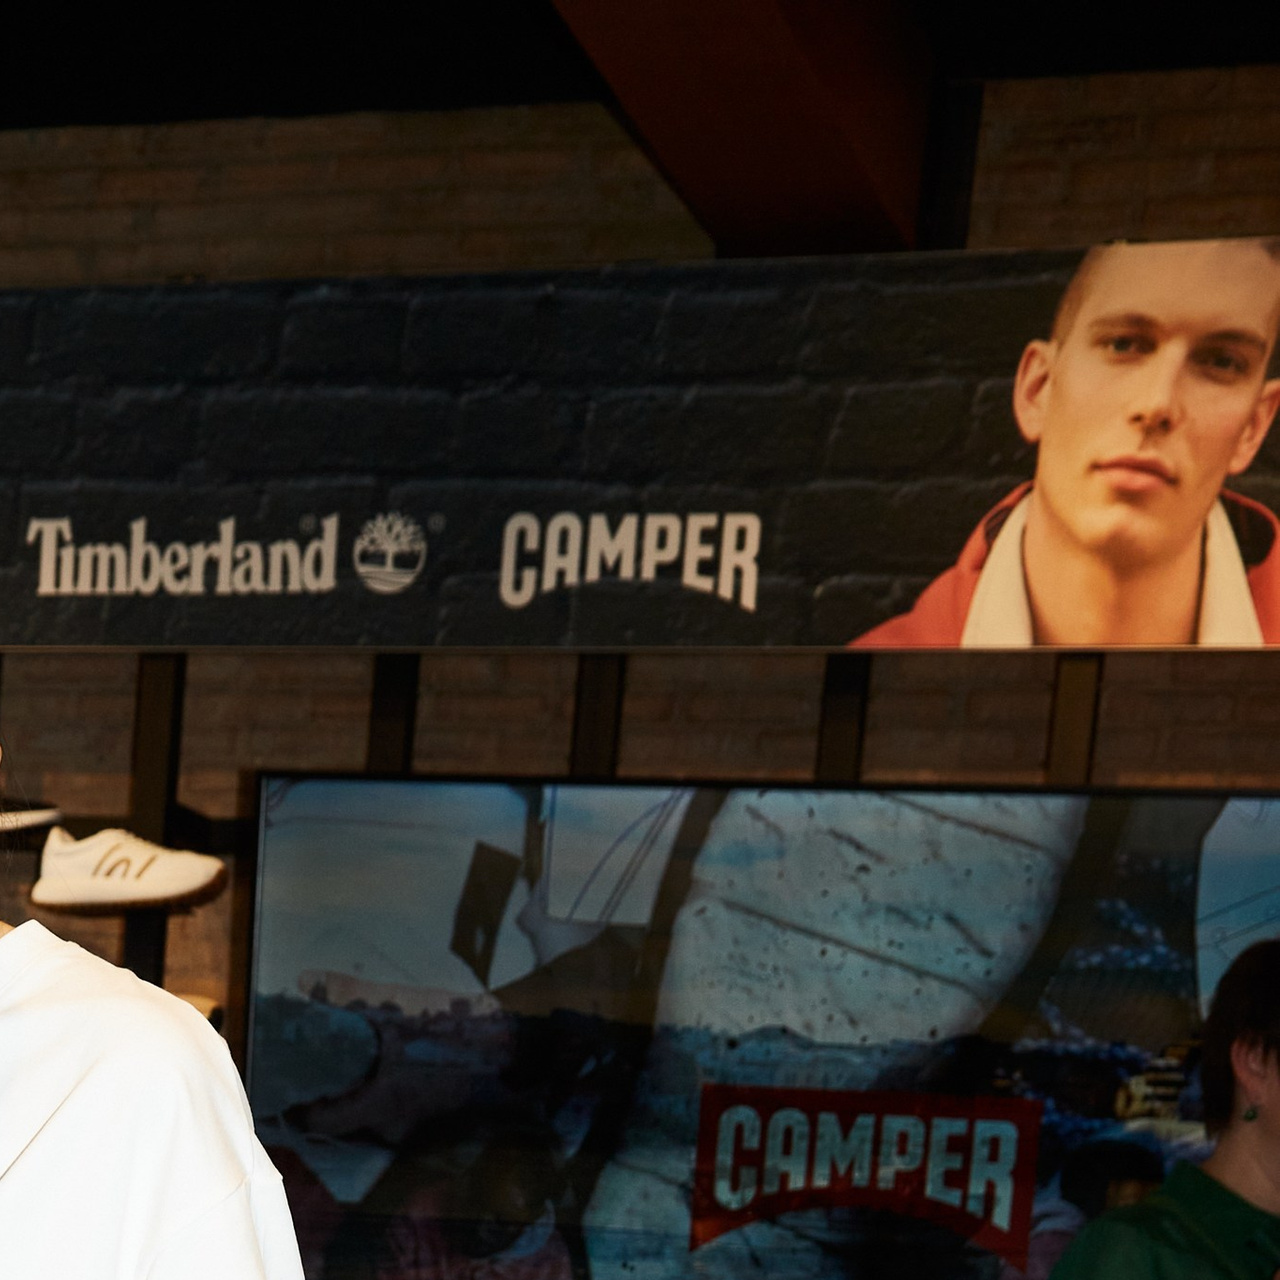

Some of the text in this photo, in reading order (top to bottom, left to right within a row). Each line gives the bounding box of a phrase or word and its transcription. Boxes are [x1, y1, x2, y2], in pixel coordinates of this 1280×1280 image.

[27, 514, 339, 598] Timberland
[501, 511, 762, 613] CAMPER
[715, 1104, 1019, 1232] CAMPER
